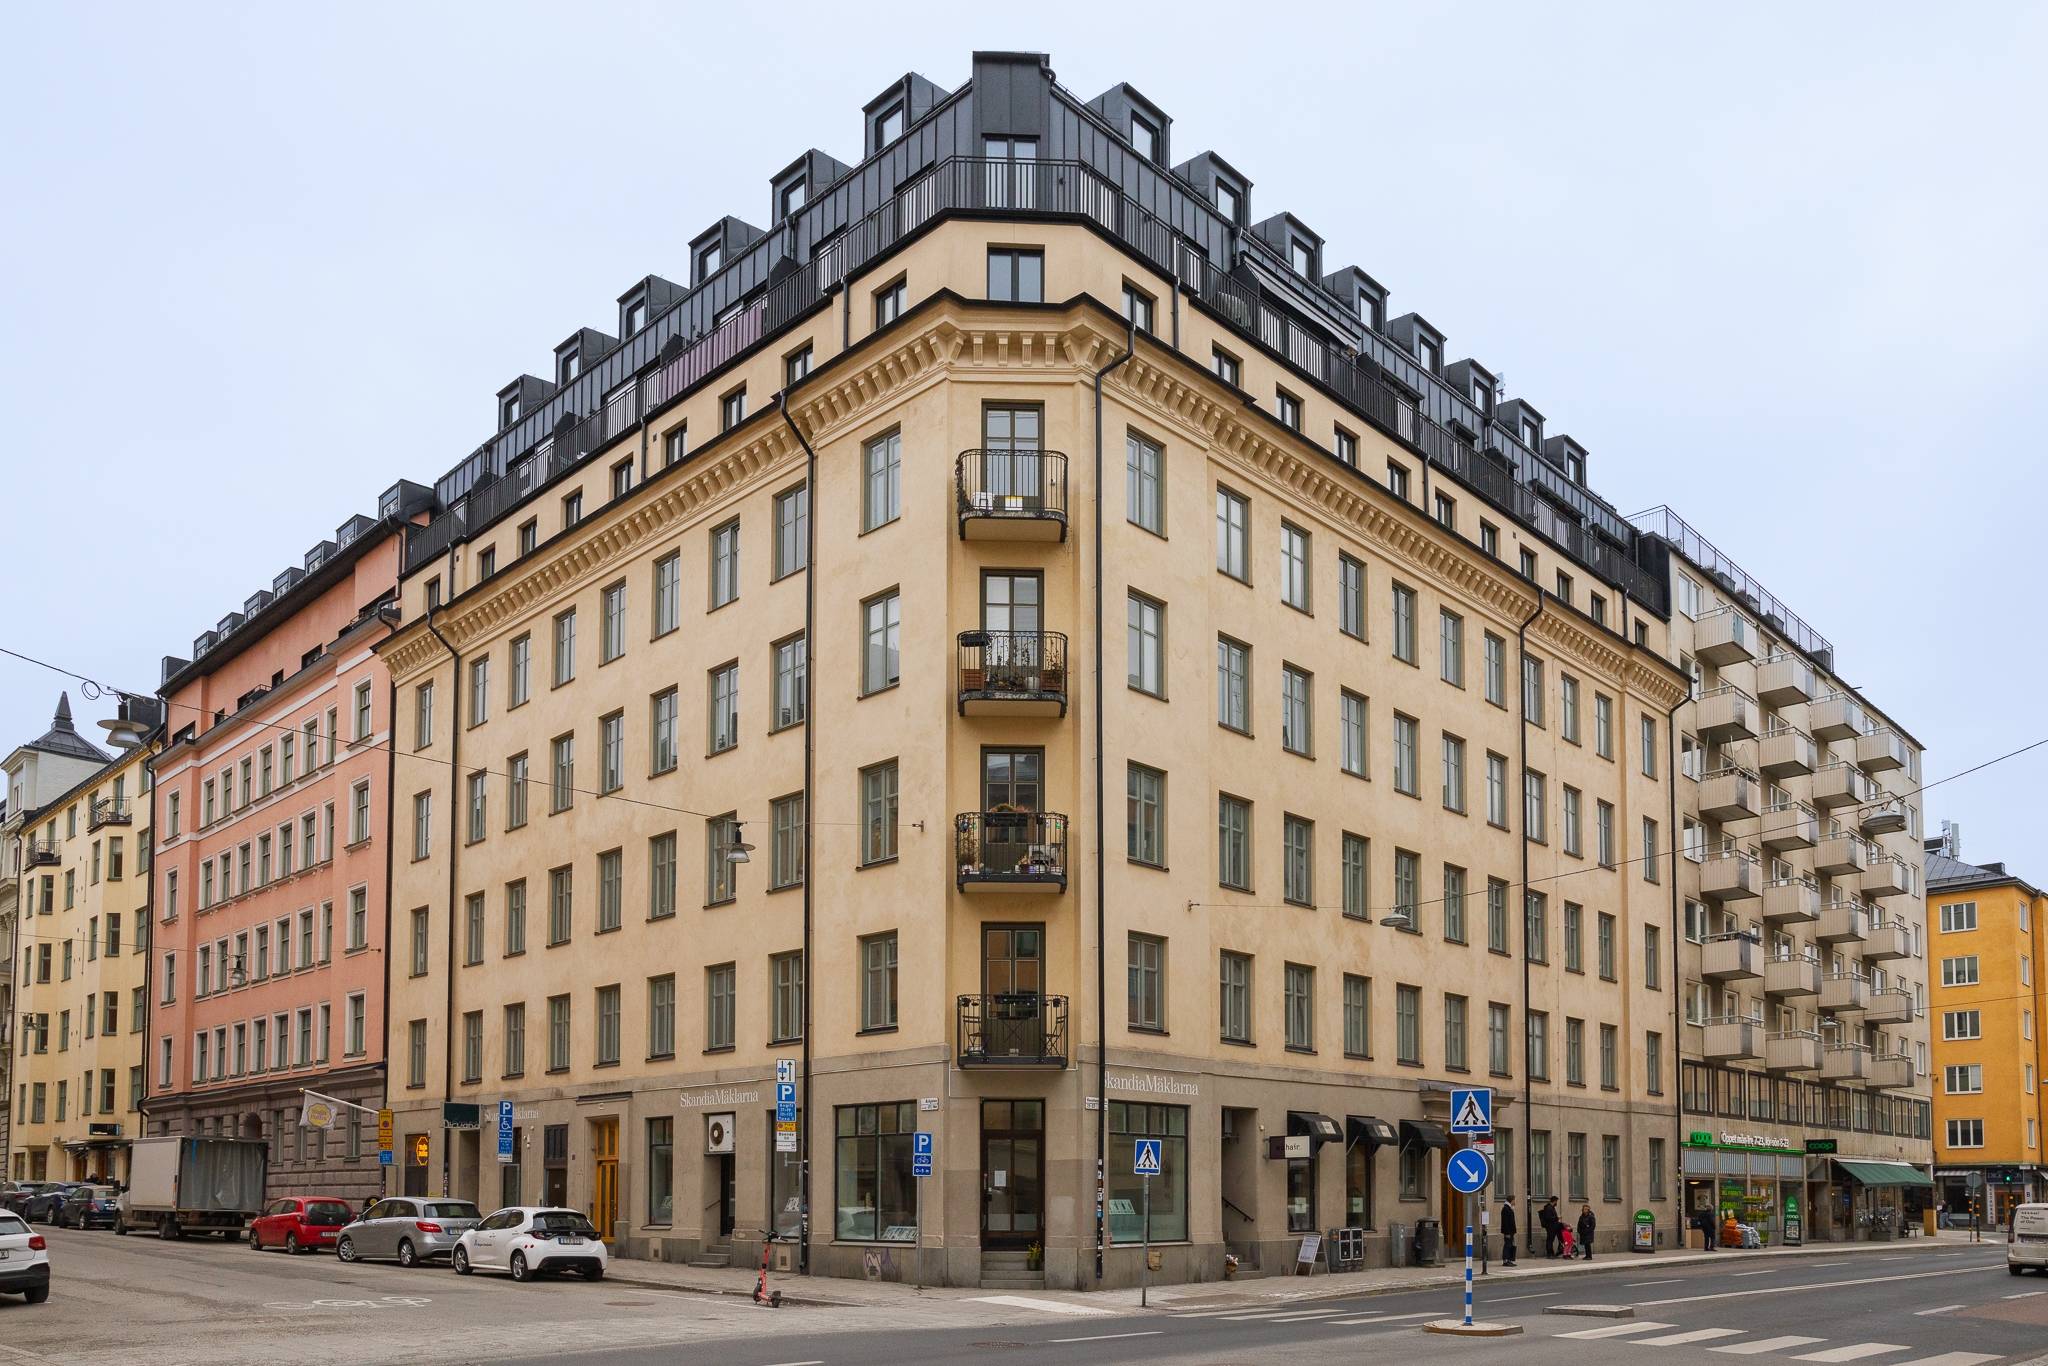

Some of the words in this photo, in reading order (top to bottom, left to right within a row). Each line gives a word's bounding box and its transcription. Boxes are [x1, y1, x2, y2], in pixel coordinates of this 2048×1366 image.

[680, 1088, 759, 1107] SkandiaMäklarna
[782, 1085, 792, 1100] P
[502, 1102, 511, 1115] P
[918, 1135, 930, 1152] P
[1808, 1142, 1834, 1150] coop
